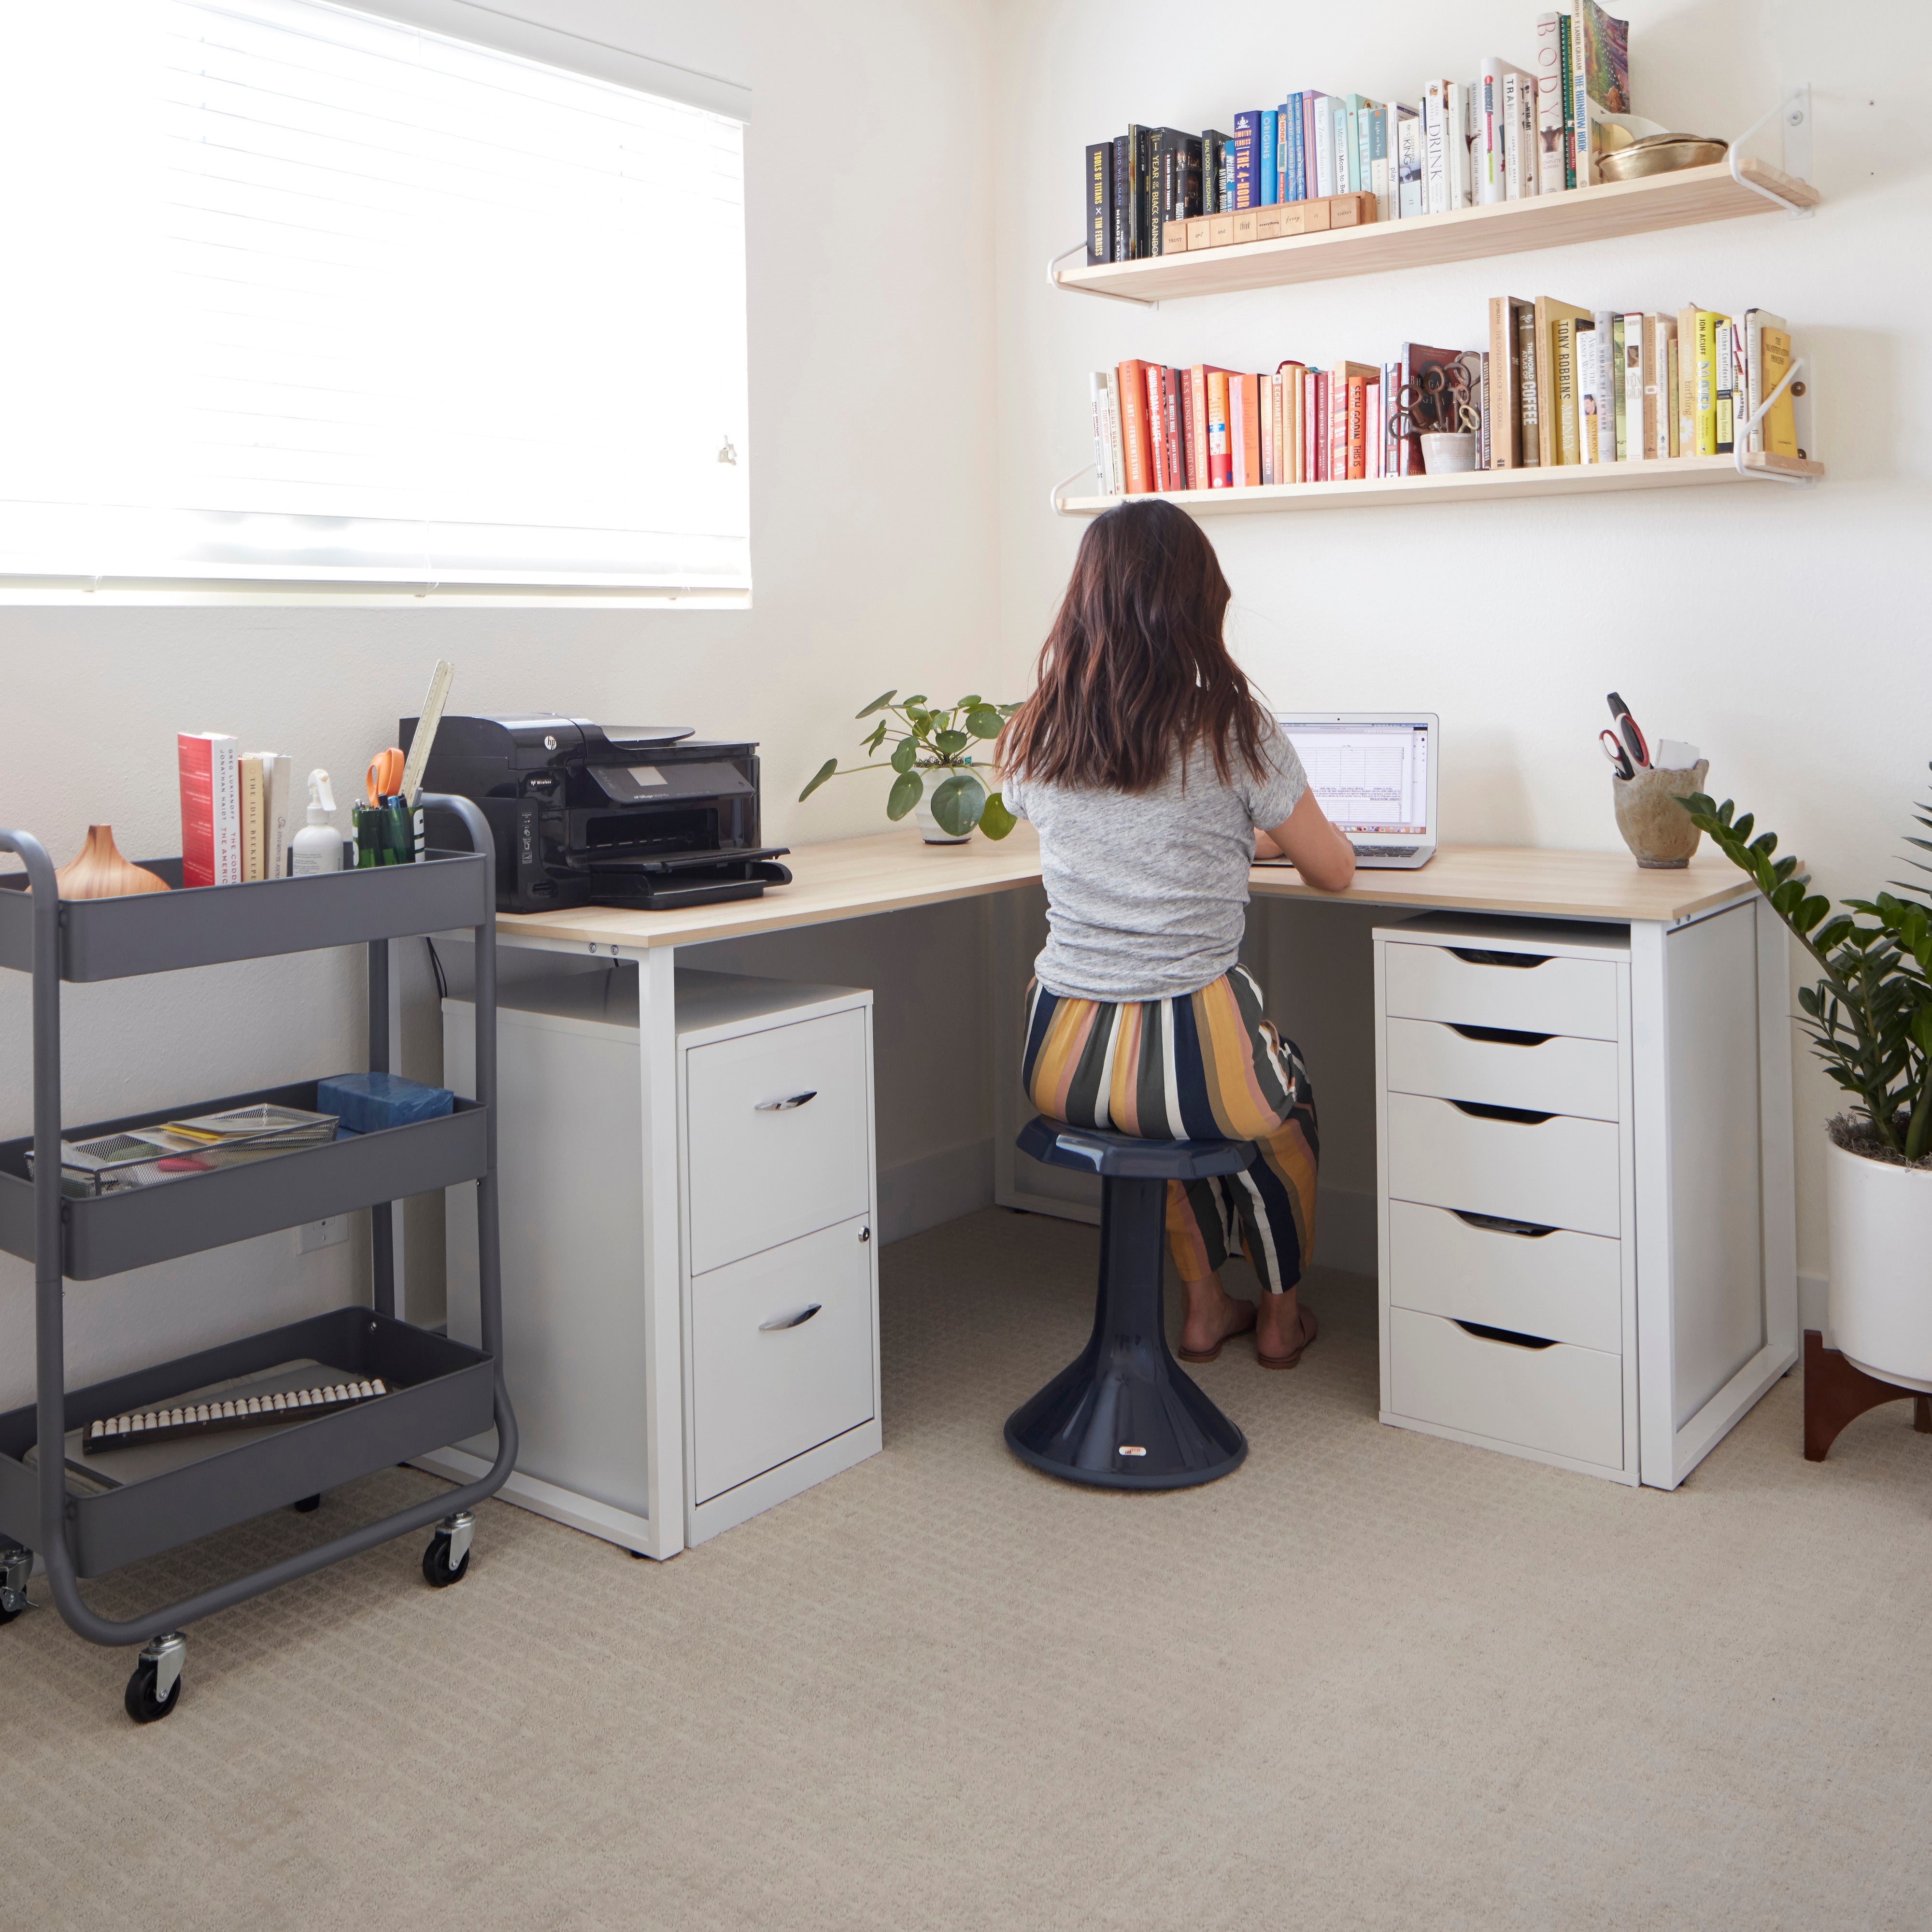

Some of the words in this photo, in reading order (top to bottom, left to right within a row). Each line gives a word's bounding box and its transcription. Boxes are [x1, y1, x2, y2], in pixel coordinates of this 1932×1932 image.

[1537, 20, 1559, 119] BODY
[1575, 73, 1584, 89] THE
[1576, 90, 1586, 128] RAINBOW
[1234, 129, 1252, 139] TIMOTHY
[1235, 138, 1251, 147] FERRISS
[1577, 131, 1587, 154] BOOK
[1237, 150, 1250, 170] THE
[1403, 140, 1411, 165] KING
[1429, 124, 1442, 181] DRINK
[1227, 156, 1235, 184] INFLUENCE
[1389, 167, 1397, 182] play
[1094, 182, 1103, 205] TITANS
[1237, 172, 1250, 209] 4-HOUR
[1239, 221, 1250, 230] think
[1095, 230, 1103, 256] FERRISS
[1558, 322, 1569, 349] TONY
[1696, 361, 1710, 378] DO
[1721, 353, 1730, 390] Confidential
[1770, 354, 1784, 365] PROCESS
[1522, 370, 1529, 380] OF
[1559, 354, 1571, 400] ROBBINS
[1600, 382, 1605, 390] OF
[1150, 396, 1159, 411] DAY
[1350, 385, 1361, 408] SETH
[1521, 381, 1537, 426] COFFEE
[1682, 381, 1695, 416] birthing
[1696, 380, 1711, 411] OVER
[1196, 412, 1202, 421] OF
[1350, 411, 1360, 440] GODIN
[1563, 405, 1575, 451] MONEY
[1183, 398, 1192, 431] IYENGAR
[1188, 466, 1194, 476] ON
[1128, 426, 1139, 480] FERMENTATION
[547, 736, 555, 751] hp
[278, 816, 286, 830] The
